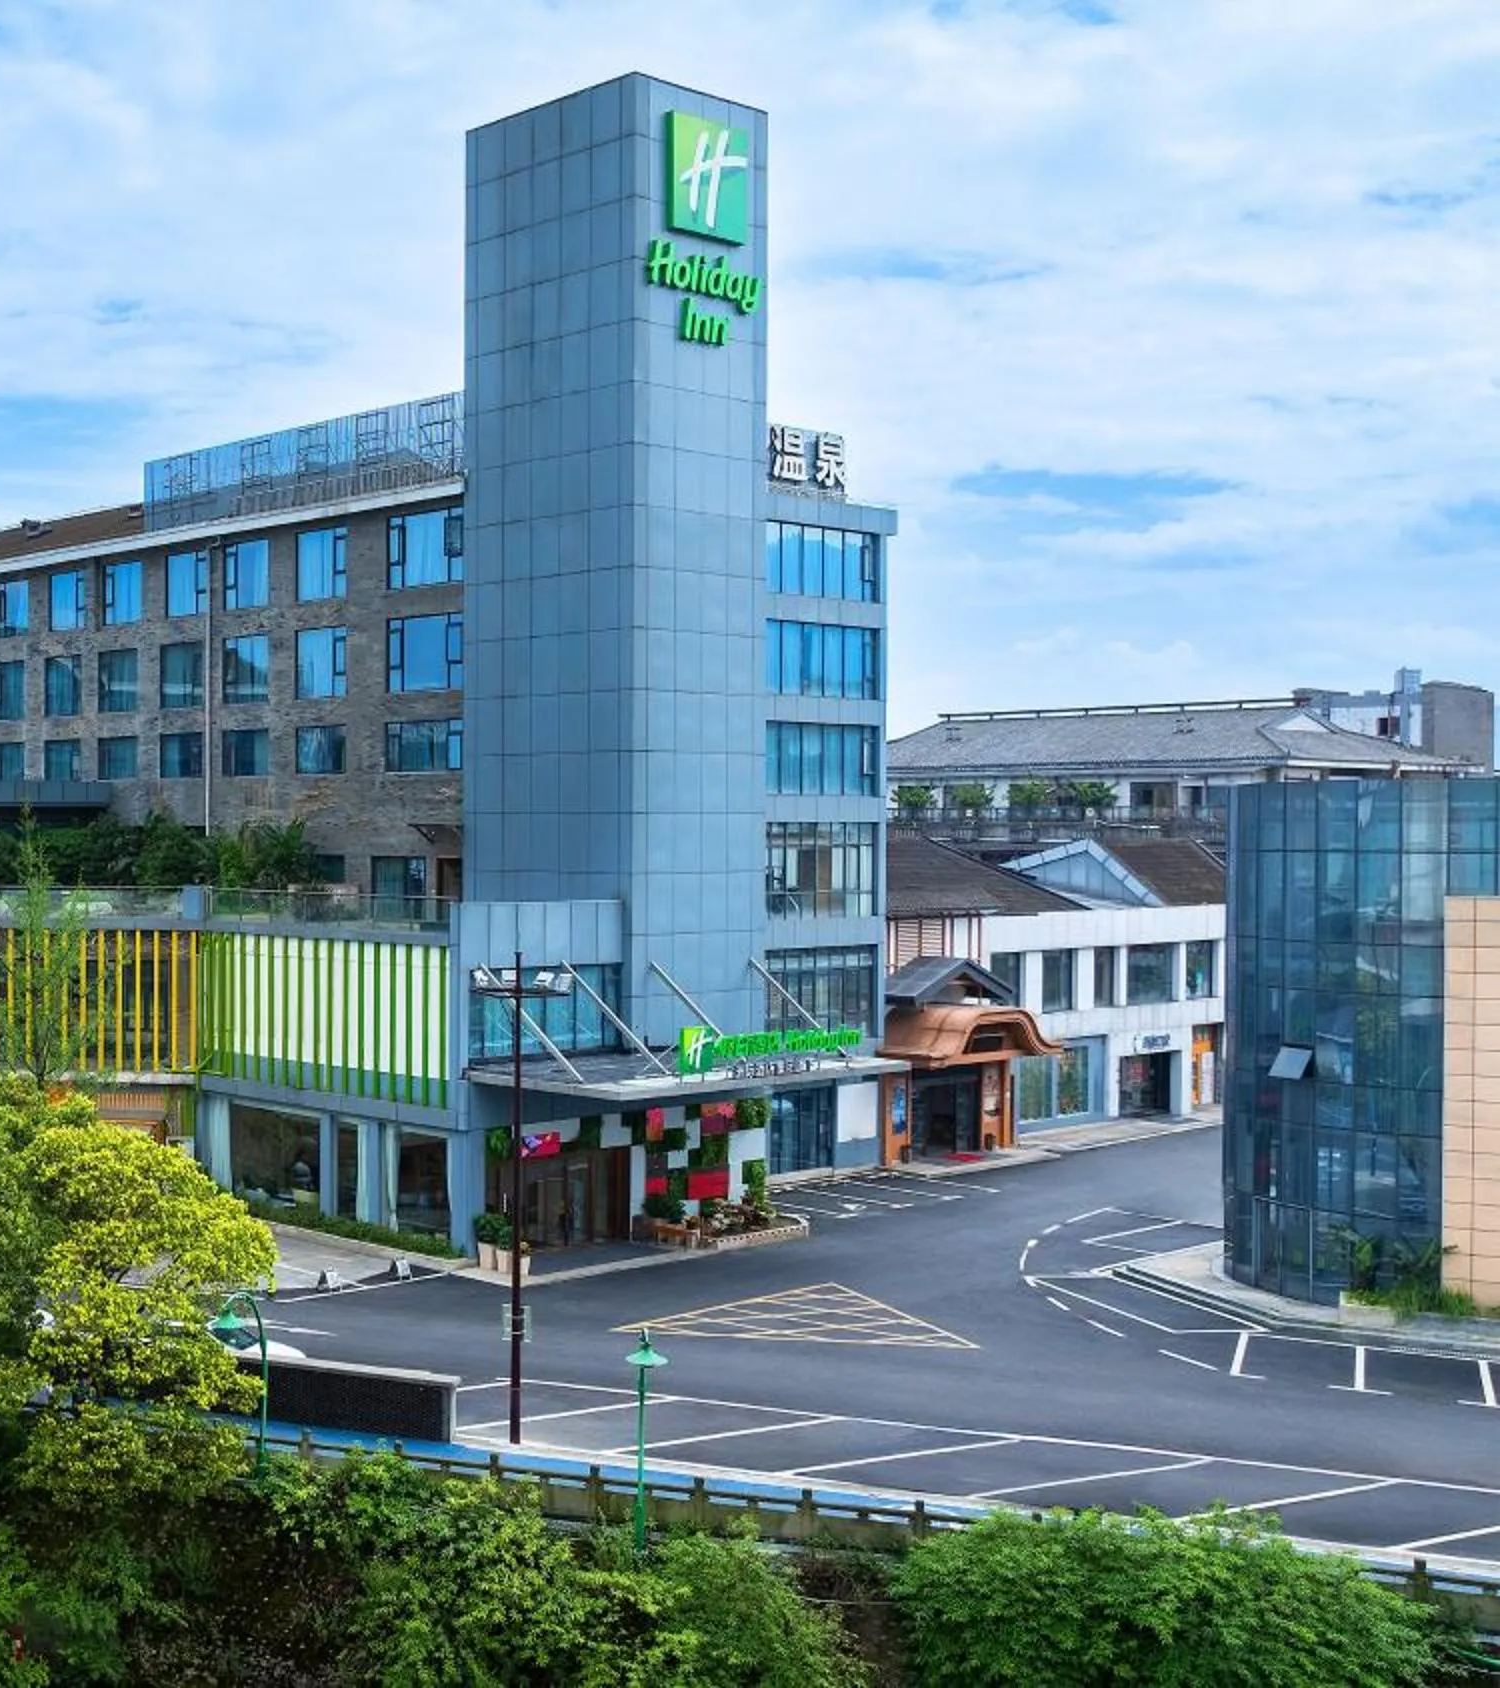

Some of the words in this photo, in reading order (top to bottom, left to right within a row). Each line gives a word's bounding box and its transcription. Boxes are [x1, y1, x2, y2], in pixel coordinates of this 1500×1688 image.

[646, 239, 761, 315] Holiday
[680, 298, 729, 346] Inn
[770, 424, 846, 487] 温泉
